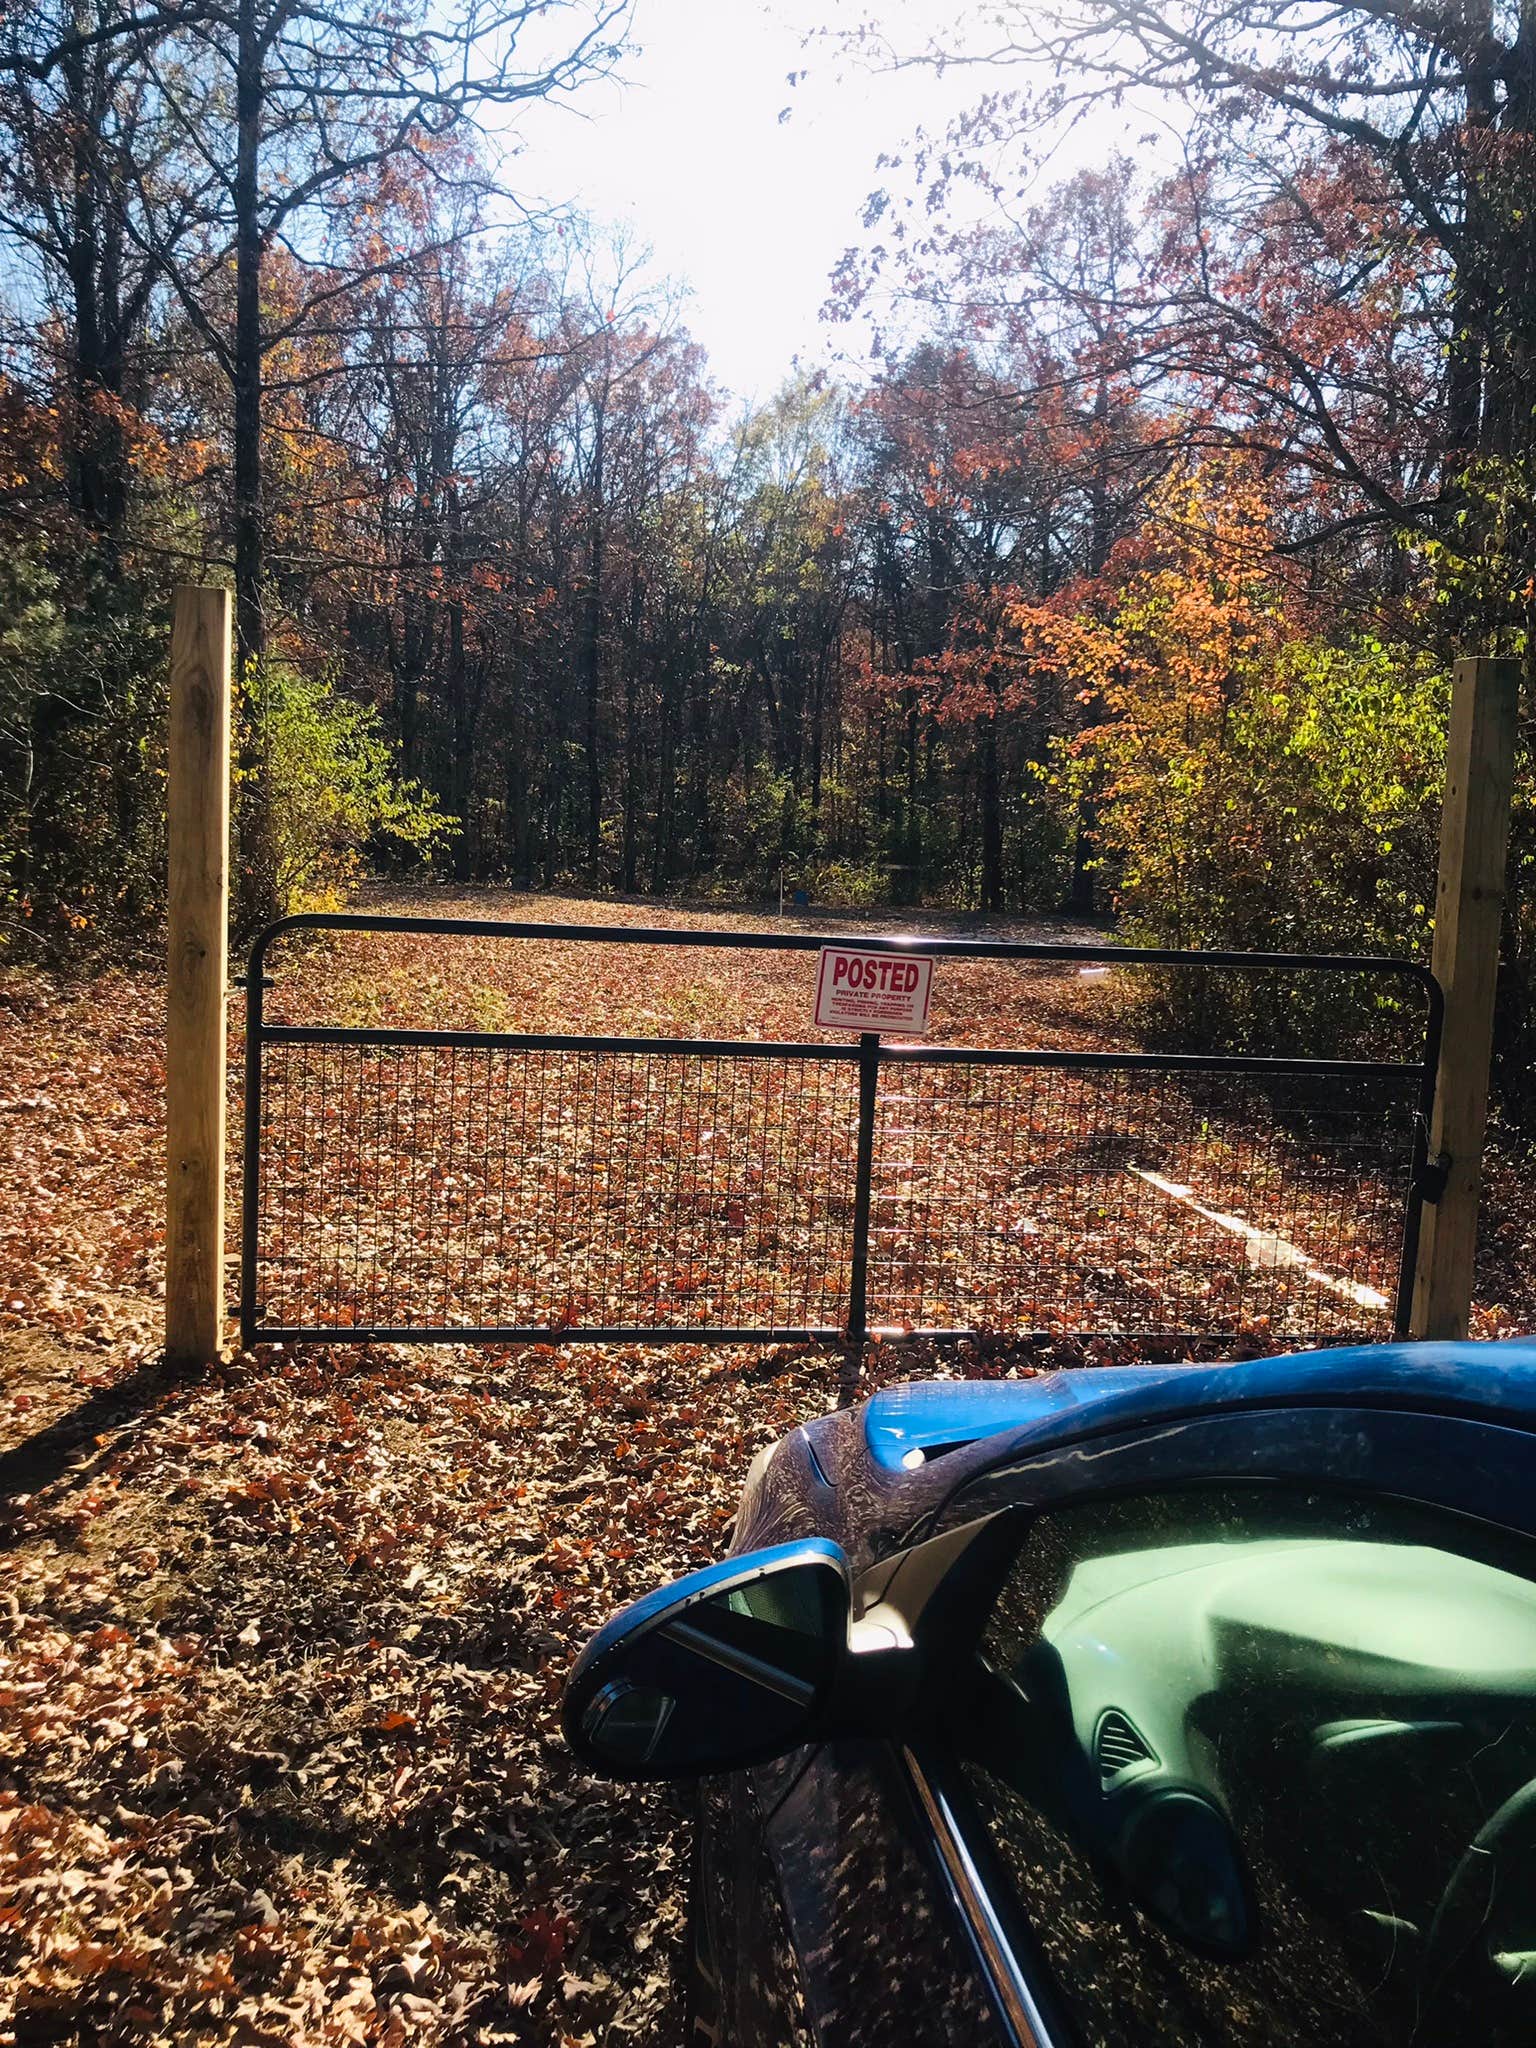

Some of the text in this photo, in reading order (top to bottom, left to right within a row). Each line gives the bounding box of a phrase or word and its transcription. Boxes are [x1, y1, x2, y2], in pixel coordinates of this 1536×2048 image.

[833, 957, 919, 993] POSTED
[836, 990, 911, 1002] PRIVATE PROPERTY
